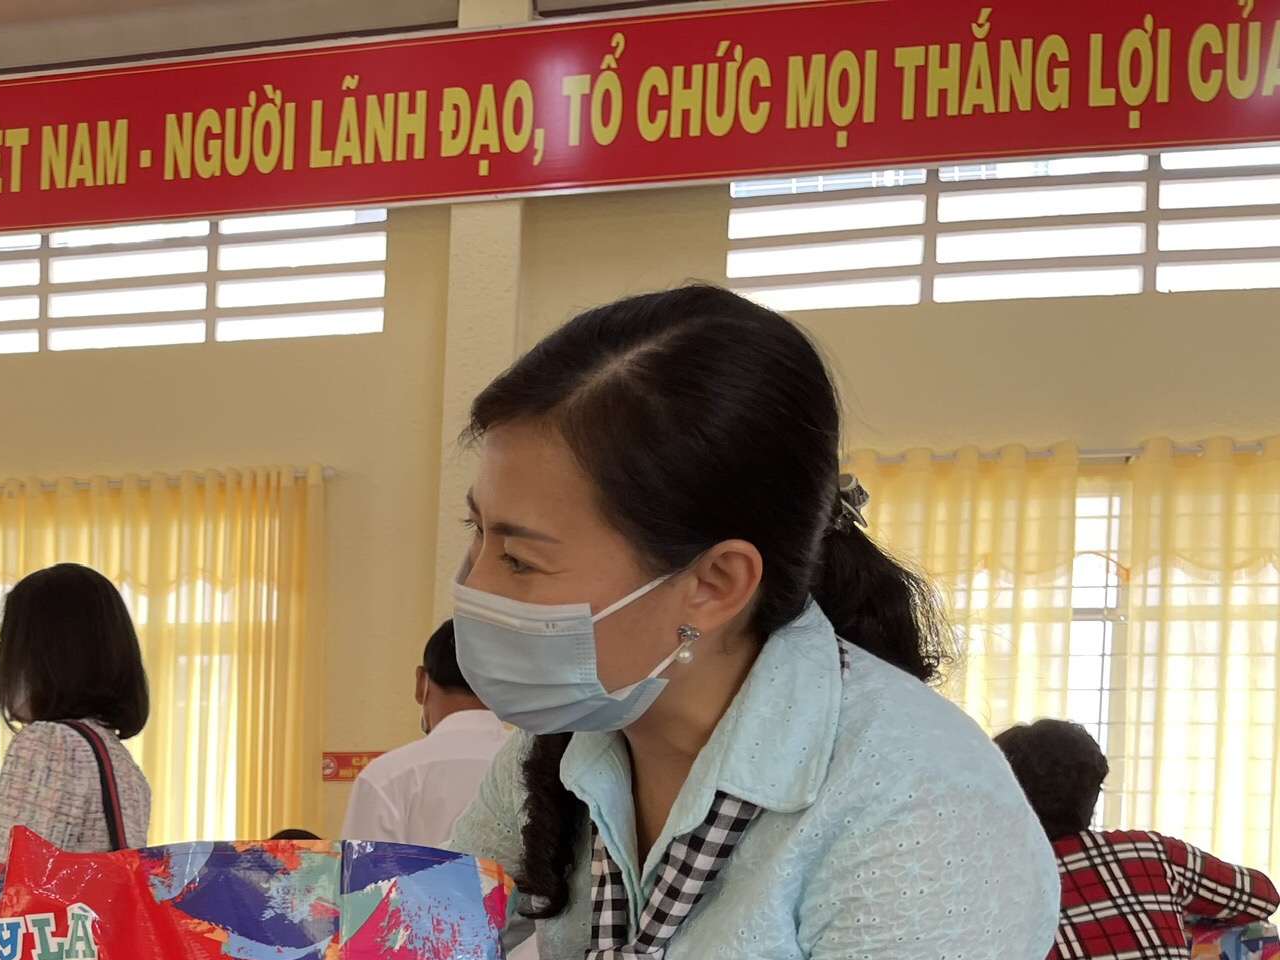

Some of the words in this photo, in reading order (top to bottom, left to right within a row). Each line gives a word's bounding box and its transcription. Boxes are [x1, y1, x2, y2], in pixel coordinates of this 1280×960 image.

[40, 118, 129, 191] NAM
[163, 84, 296, 181] NGƯỜI
[308, 74, 428, 169] LÃNH
[438, 78, 545, 177] ĐẠO,
[561, 32, 626, 147] TỔ
[636, 40, 771, 142] CHỨC
[785, 49, 878, 148] MỌI
[893, 7, 1071, 118] THẮNG
[1088, 13, 1172, 129] LỢI
